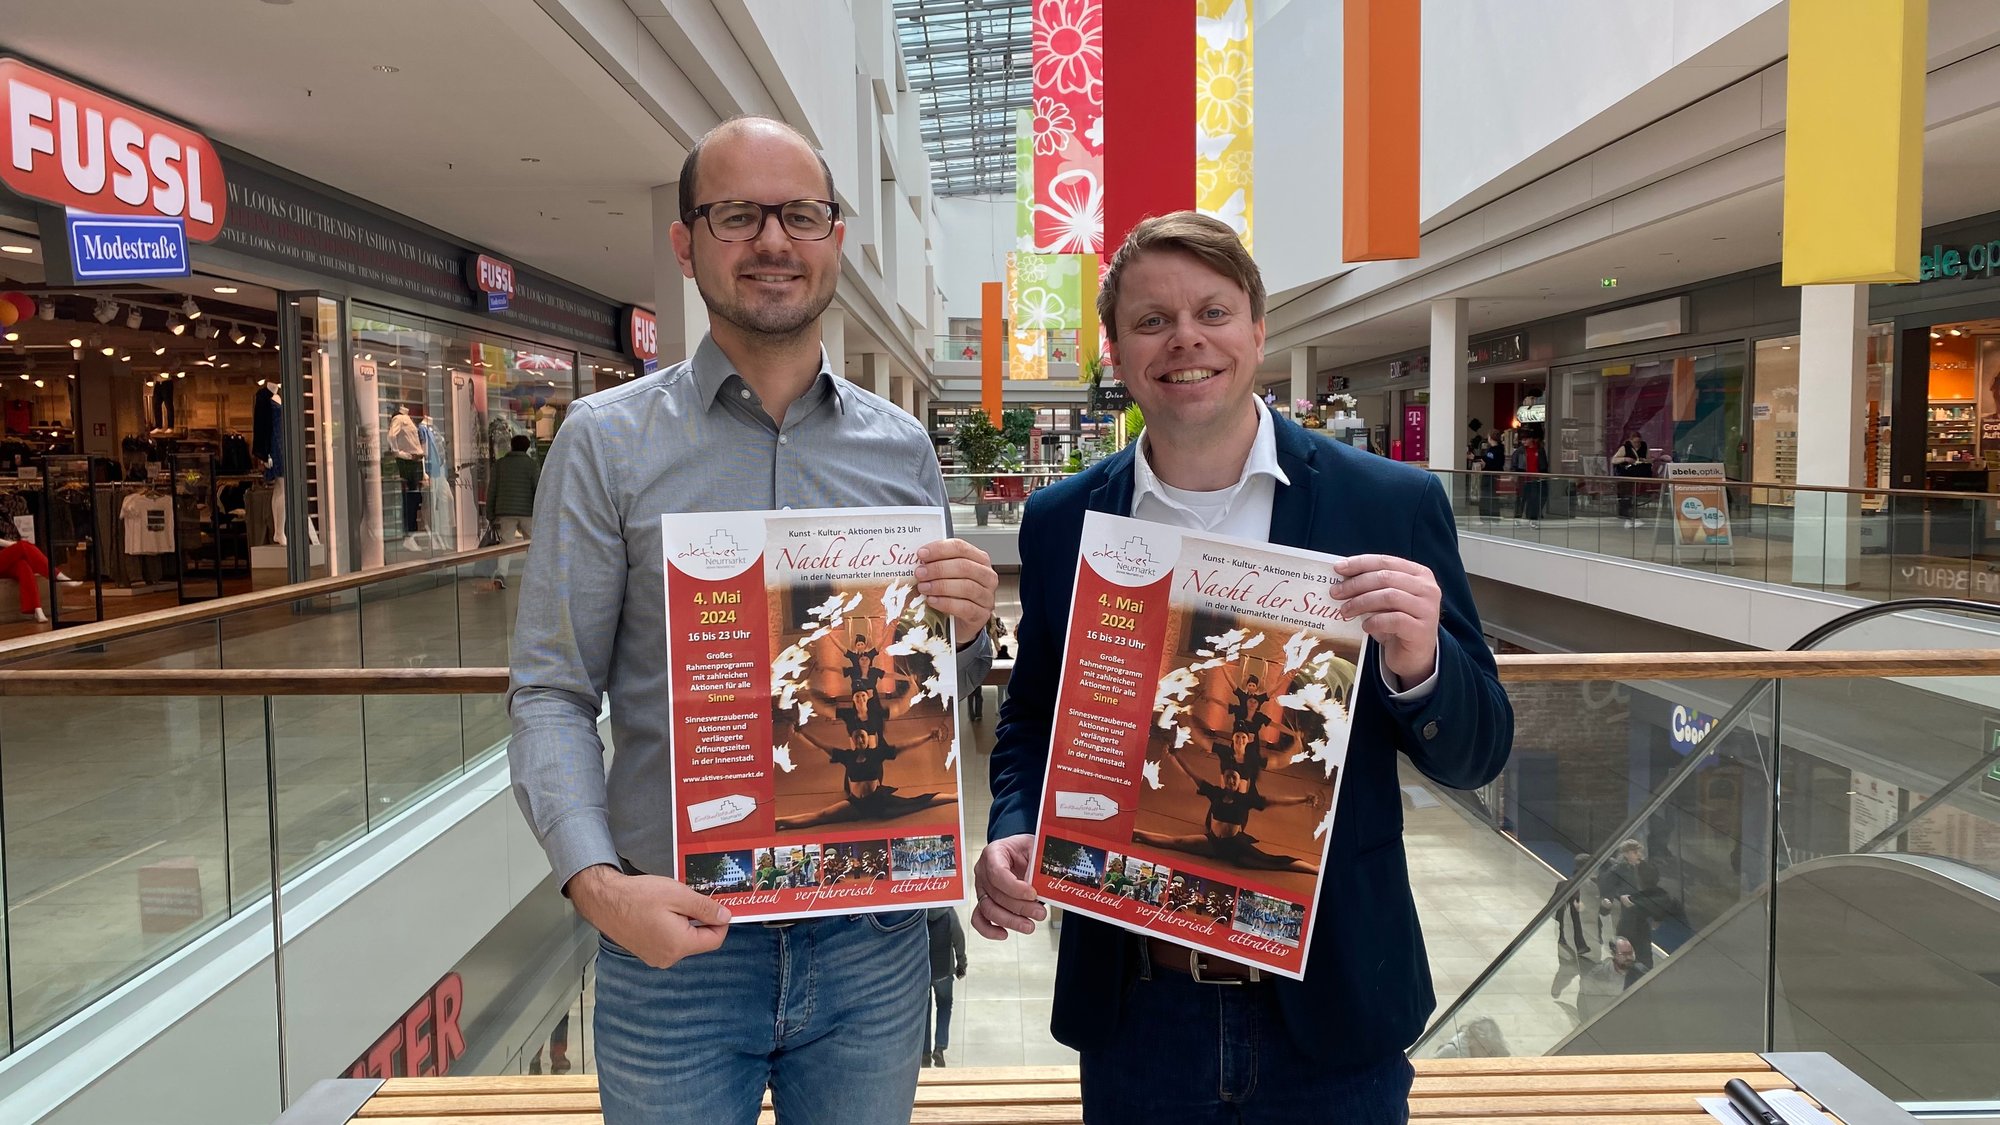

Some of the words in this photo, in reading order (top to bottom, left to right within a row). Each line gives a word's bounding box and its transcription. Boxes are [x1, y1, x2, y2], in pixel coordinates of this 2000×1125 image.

[9, 79, 214, 225] FUSSL
[244, 187, 287, 218] LOOKS
[358, 226, 397, 254] FASHION
[399, 241, 416, 261] NEW
[418, 248, 444, 271] LOOKS
[83, 234, 178, 260] Modestraße
[222, 227, 248, 245] STYLE
[250, 234, 276, 252] LOOKS
[278, 242, 300, 258] GOOD
[480, 260, 514, 293] FUSSL
[635, 316, 657, 354] FUS
[817, 528, 841, 537] Kultur
[848, 527, 883, 536] Aktionen
[884, 526, 896, 534] bis
[897, 526, 906, 534] 23
[705, 557, 746, 566] Neumarkt
[776, 536, 846, 570] Nacht
[848, 538, 880, 570] der
[883, 543, 923, 566] Sinn
[810, 572, 823, 581] der
[825, 571, 871, 580] Neumarkter
[873, 569, 914, 578] Innenstadt
[1116, 562, 1156, 576] Neumarkt
[1202, 553, 1225, 565] Kunst
[1232, 558, 1257, 570] Kultur
[1263, 564, 1301, 579] Aktionen
[1303, 571, 1314, 582] bis
[1316, 574, 1327, 584] 23
[1329, 577, 1343, 585] Uh
[1182, 568, 1260, 602] Nacht
[1256, 580, 1292, 609] der
[693, 592, 707, 605] 4.
[712, 590, 741, 604] Mai
[1098, 593, 1111, 607] 4.
[1116, 596, 1144, 614] Mai
[700, 610, 736, 624] 2024
[1100, 613, 1136, 631] 2024
[1214, 601, 1228, 611] der
[1230, 604, 1279, 621] Neumarkter
[1281, 614, 1325, 631] Innenstadt
[688, 632, 700, 642] 16
[702, 631, 716, 641] bis
[718, 631, 730, 640] 23
[733, 630, 751, 639] Uhr
[1086, 630, 1098, 640] 16
[1099, 632, 1113, 643] bis
[1114, 635, 1127, 646] 23
[1128, 638, 1146, 650] Uhr
[706, 652, 733, 660] Großes
[1100, 653, 1125, 665] Großes
[686, 661, 754, 672] Rahmenprogramm
[1079, 658, 1143, 679] Rahmenprogramm
[692, 673, 706, 681] mit
[707, 671, 748, 680] zahlreichen
[1083, 670, 1096, 679] mit
[1096, 673, 1135, 687] zahlreichen
[690, 683, 724, 692] Aktionen
[725, 682, 737, 690] für
[738, 681, 751, 689] alle
[1079, 679, 1111, 692] Aktionen
[1111, 684, 1123, 694] für
[1123, 687, 1136, 697] alle
[708, 694, 735, 703] Sinne
[1093, 692, 1119, 706] Sinne
[685, 712, 758, 724] Sinnesverzaubernde
[1068, 708, 1137, 729] Sinnesverzaubernde
[697, 724, 731, 733] Aktionen
[732, 723, 747, 731] und
[1078, 720, 1110, 734] Aktionen
[1110, 727, 1125, 737] und
[701, 733, 744, 744] verlängerte
[1080, 731, 1119, 746] verlängerte
[695, 743, 750, 754] Öffnungszeiten
[1073, 738, 1124, 757] Öffnungszeiten
[692, 757, 700, 766] in
[701, 756, 714, 765] der
[715, 754, 754, 764] Innenstadt
[1076, 750, 1088, 760] der
[1088, 753, 1126, 769] Innenstadt
[683, 771, 764, 783] www.aktives-neumarkt.de
[1056, 763, 1132, 787] www.aktives-neumarkt.de
[794, 871, 886, 913] verführerisch
[891, 876, 950, 895] attraktiv
[1047, 873, 1124, 910] überraschend
[1136, 900, 1228, 936] verführerisch
[1228, 931, 1290, 958] attraktiv
[353, 971, 467, 1077] TER
